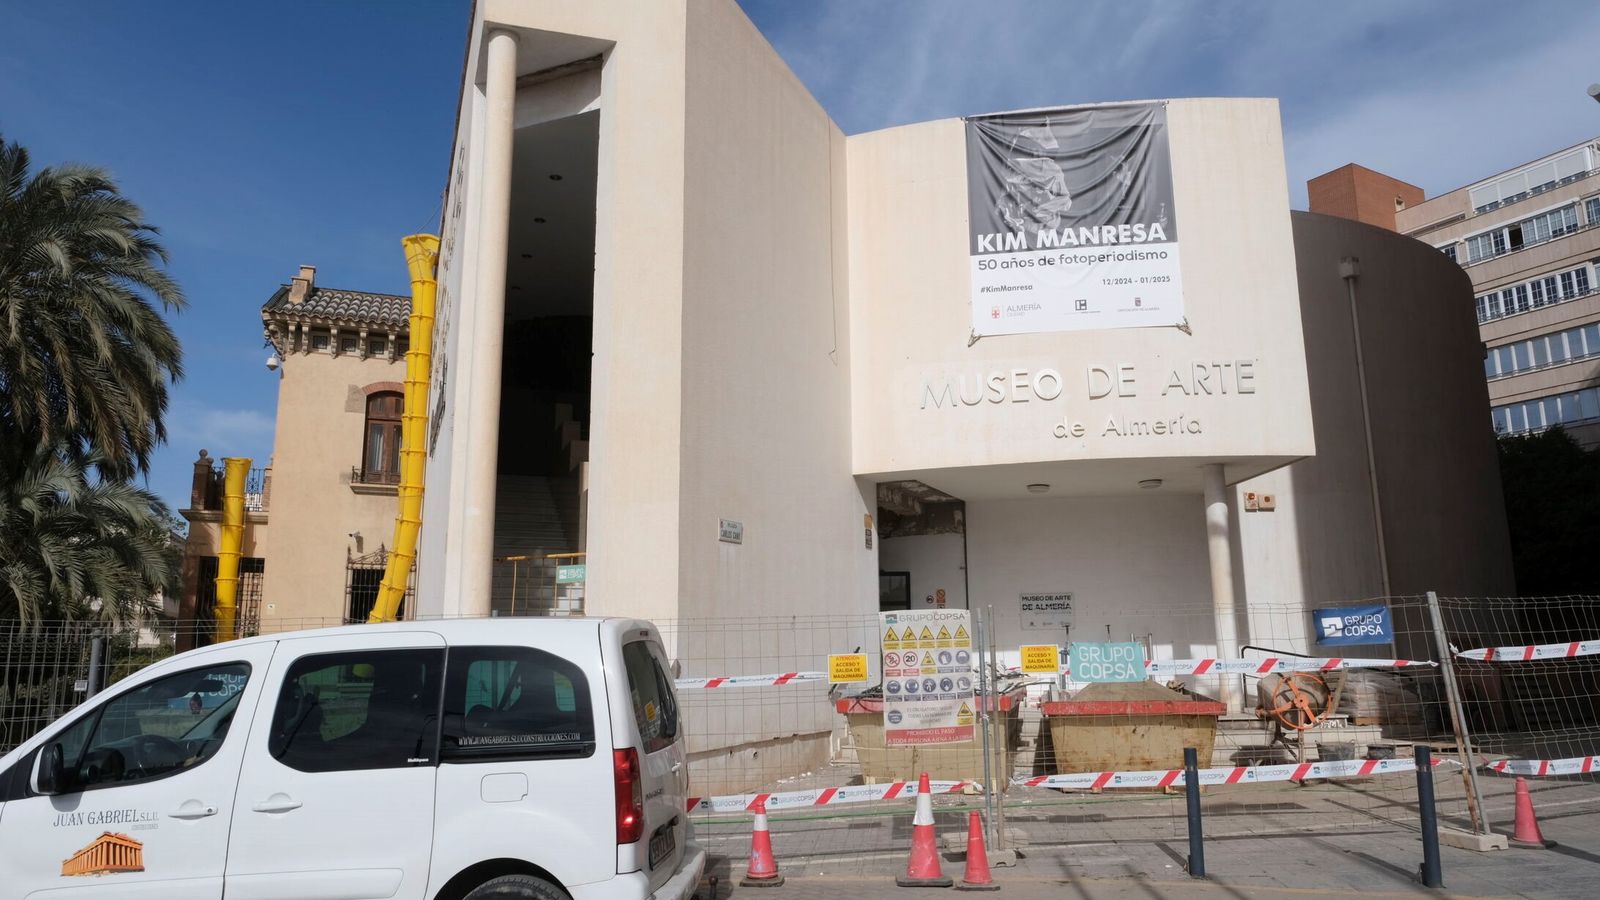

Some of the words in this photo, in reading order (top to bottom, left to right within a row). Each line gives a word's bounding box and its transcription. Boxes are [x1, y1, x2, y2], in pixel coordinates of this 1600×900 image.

[977, 232, 1027, 253] KIM
[1036, 222, 1167, 248] MANRESA
[978, 259, 998, 271] 50
[1000, 257, 1035, 269] años
[1038, 255, 1056, 266] de
[1059, 249, 1168, 266] fotoperiodismo
[1102, 277, 1133, 286] 12/2024
[1140, 275, 1171, 285] 01/2025
[980, 283, 1033, 293] #KimManresa
[1006, 302, 1042, 312] ALMERÍA
[920, 367, 1064, 410] MUSEO
[1087, 362, 1137, 400] DE
[1161, 359, 1256, 396] ARTE
[1053, 415, 1086, 439] de
[1101, 413, 1203, 438] Almería
[1022, 603, 1033, 611] DE
[1035, 601, 1072, 610] ALMERÍA
[899, 612, 966, 623] GRUPOCOPSA
[1344, 614, 1382, 626] GRUPO
[1344, 625, 1384, 636] COPSA
[905, 655, 916, 663] 20
[1079, 646, 1135, 662] GRUPO
[1079, 662, 1138, 679] COPSA
[844, 789, 882, 798] GRUPOCOPSA
[708, 799, 747, 807] GRUPOCOPSA
[53, 811, 84, 827] JUAN
[87, 809, 139, 825] GABRIEL
